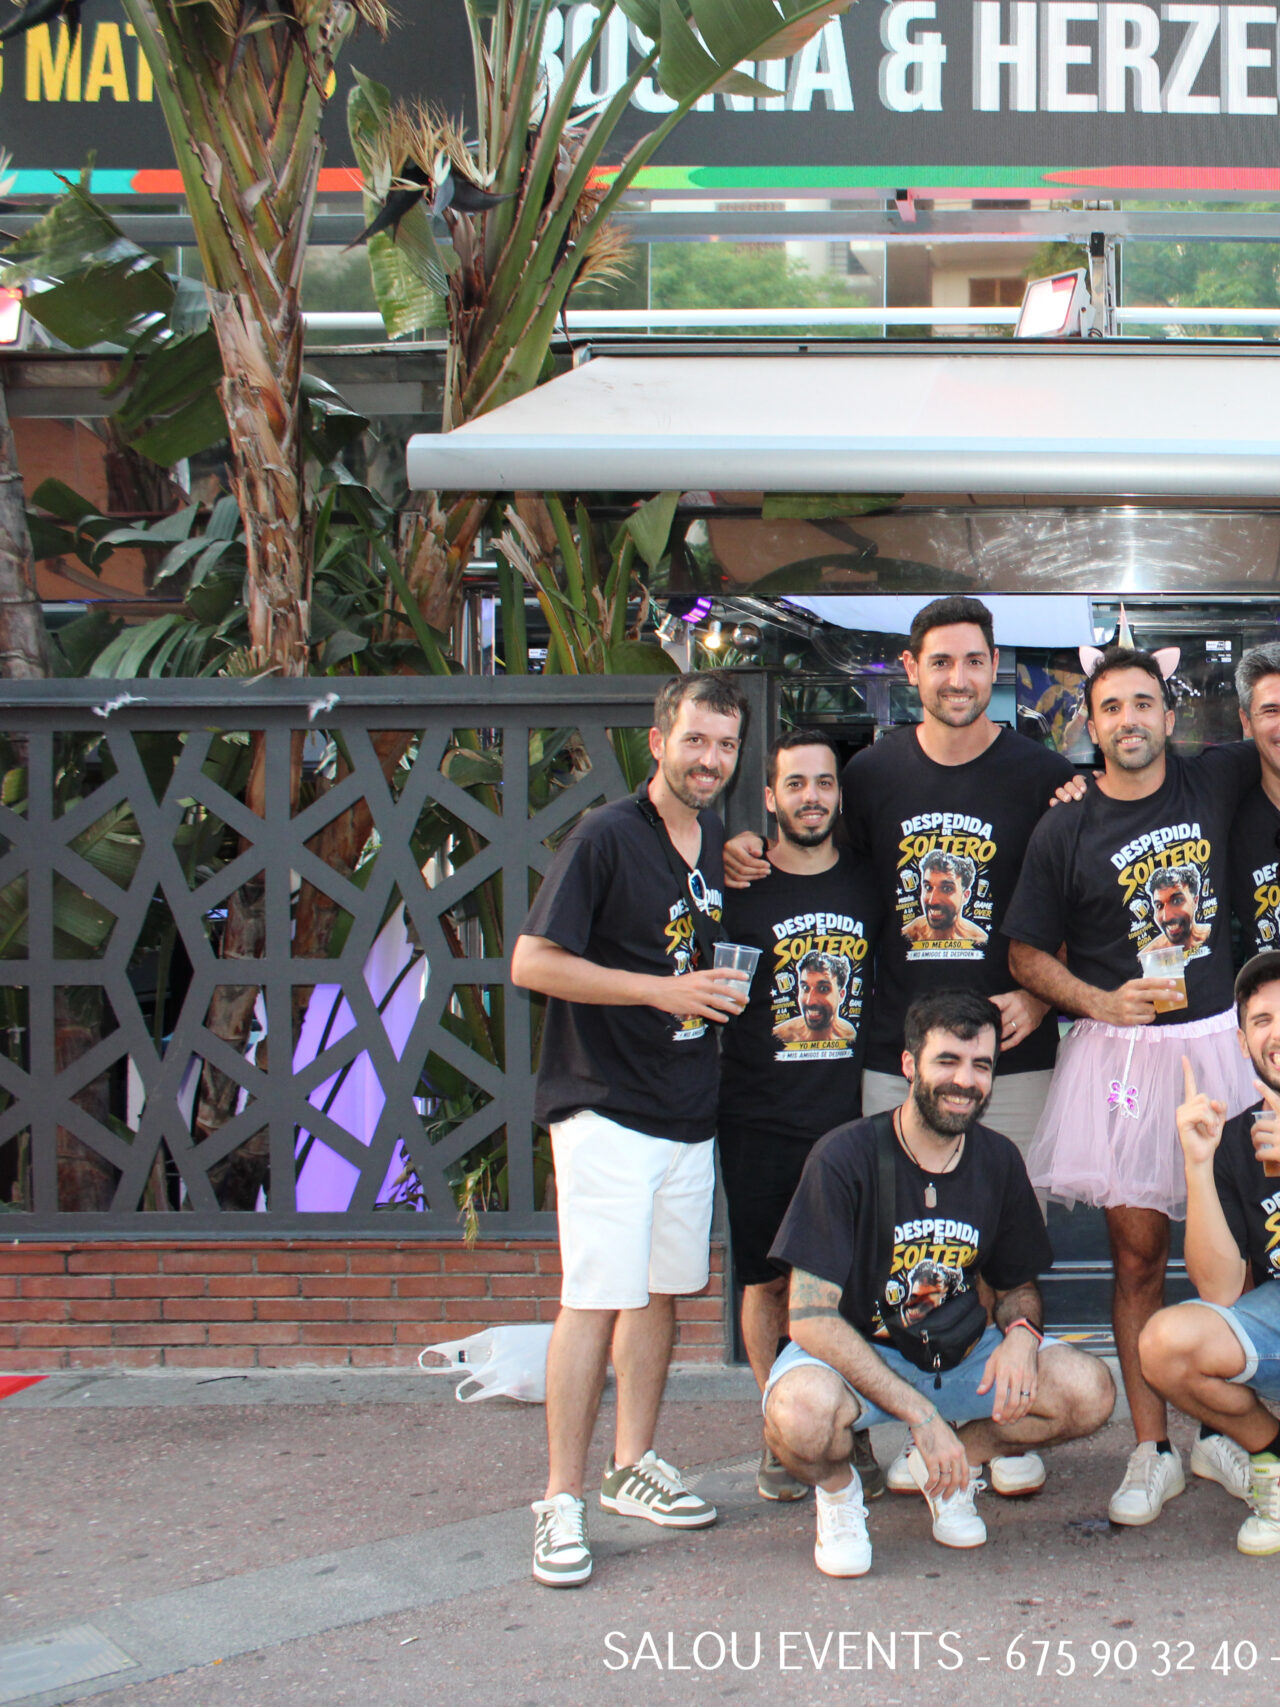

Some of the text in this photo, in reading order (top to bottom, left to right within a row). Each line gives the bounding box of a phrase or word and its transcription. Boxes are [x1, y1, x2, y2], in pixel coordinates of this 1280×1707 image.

[880, 2, 946, 113] &
[900, 812, 993, 840] DESPEDIDA
[941, 828, 953, 836] DE
[1110, 823, 1202, 870] DESPEDIDA
[772, 912, 864, 940] DESPEDIDA
[816, 928, 827, 936] DE
[894, 1218, 980, 1248] DESPEDIDA
[933, 1236, 944, 1244] DE
